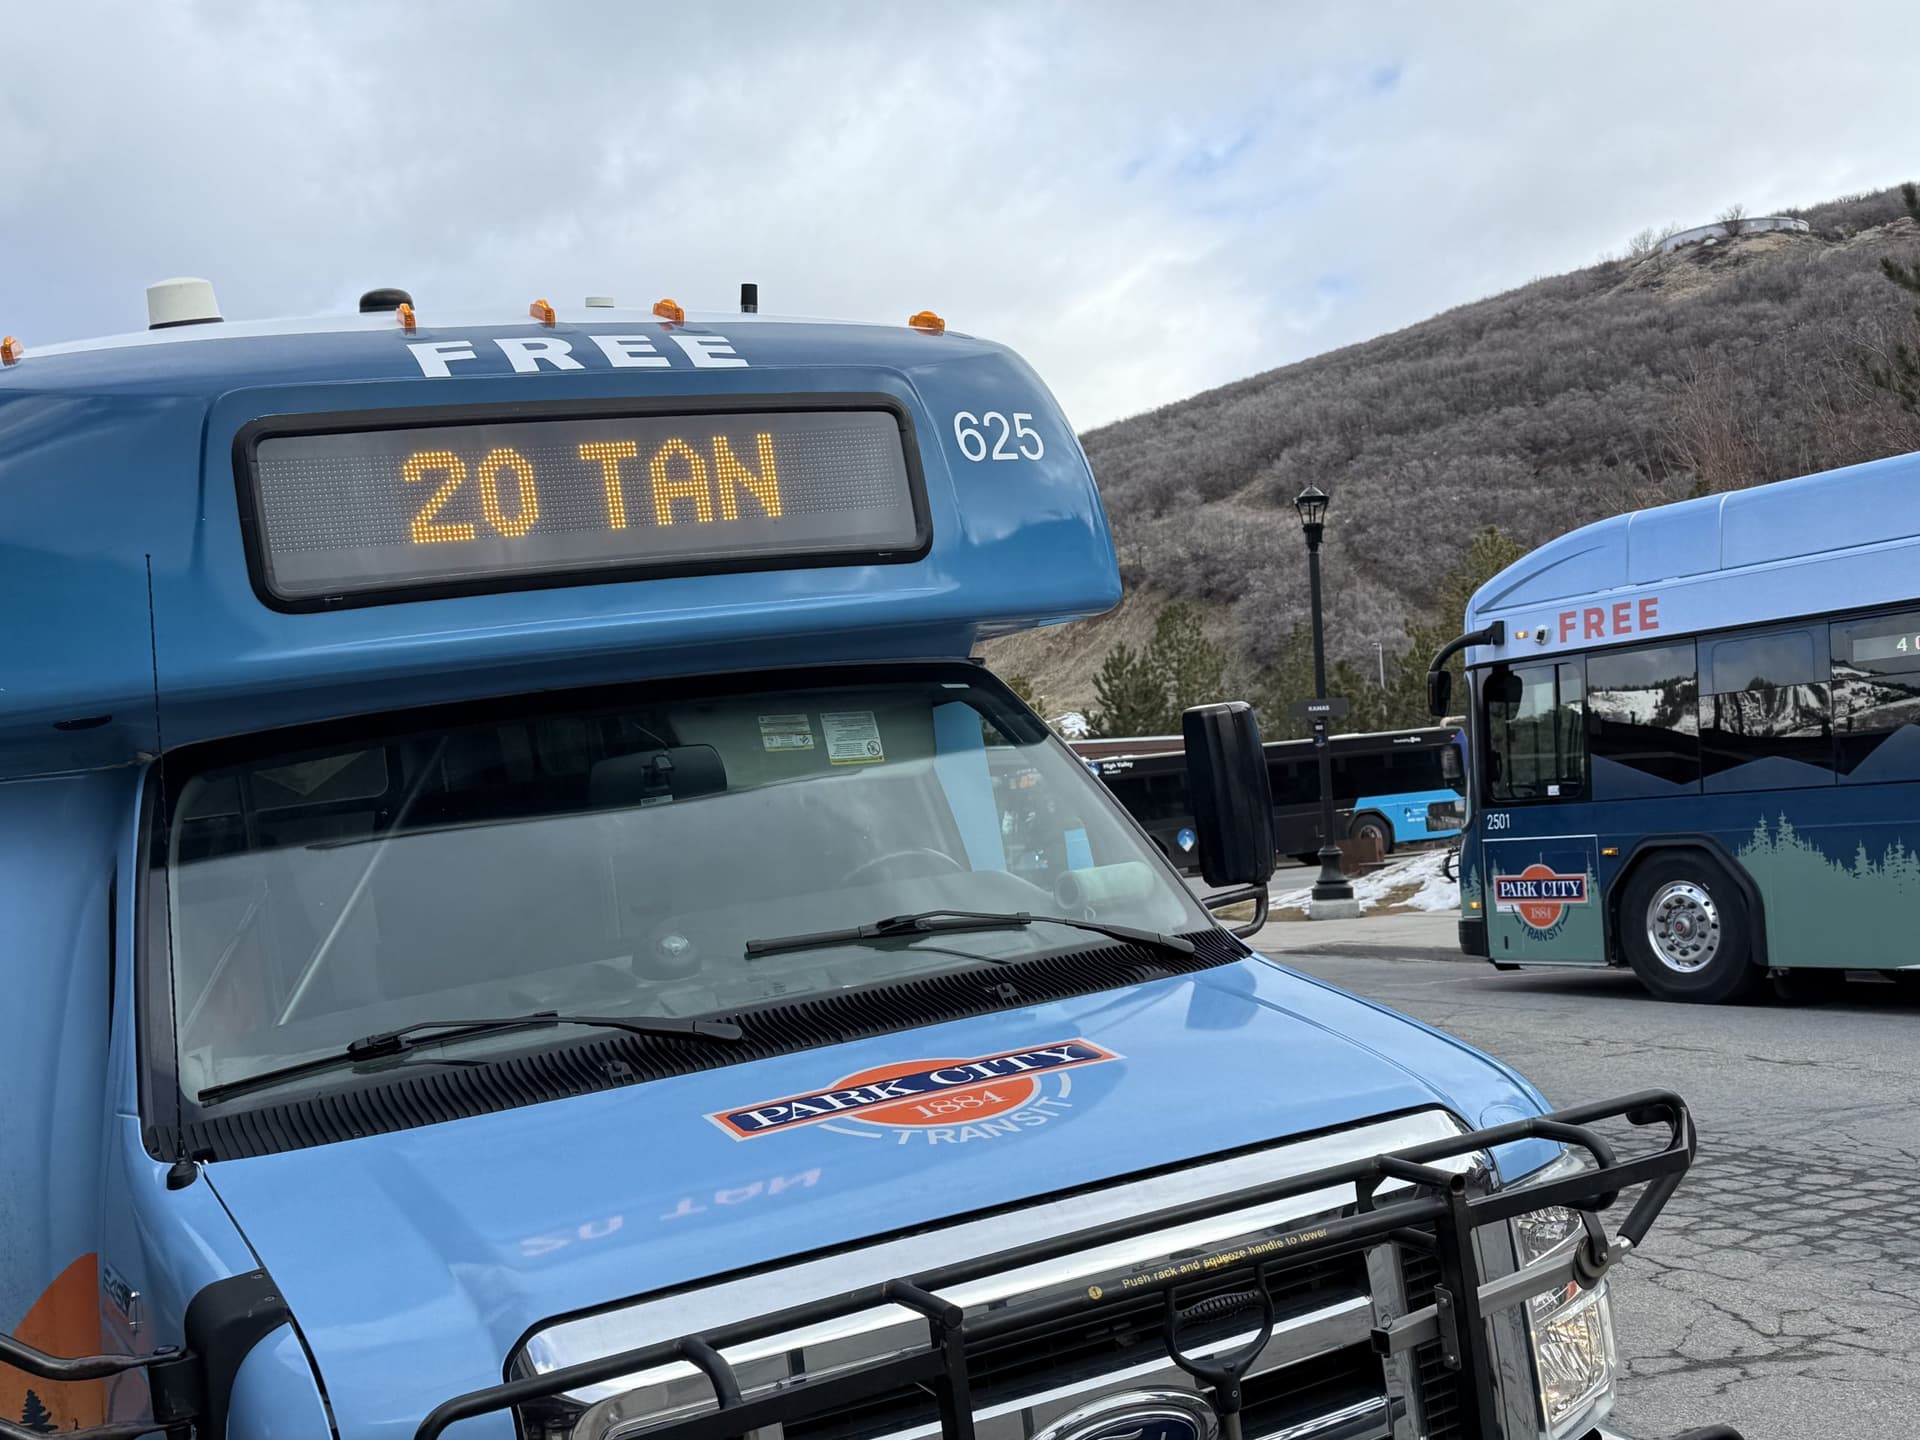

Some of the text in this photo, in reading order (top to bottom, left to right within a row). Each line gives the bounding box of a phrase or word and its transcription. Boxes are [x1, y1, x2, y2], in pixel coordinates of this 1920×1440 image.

[406, 335, 749, 379] FREE
[954, 411, 1044, 462] 625
[402, 432, 784, 544] 20 TAN
[1558, 597, 1660, 644] FREE
[1487, 813, 1511, 830] 2501
[1499, 880, 1581, 898] PARK CITY
[1522, 922, 1563, 941] TRANSIT
[1531, 907, 1552, 920] 1884
[741, 1043, 1087, 1129] PARK CITY
[911, 1089, 1009, 1120] 1884
[892, 1095, 1074, 1145] TRANSIT
[1122, 1274, 1152, 1289] Push
[1154, 1267, 1178, 1281] rack
[1180, 1260, 1201, 1274] and
[1203, 1250, 1247, 1268] squeeze
[1248, 1239, 1284, 1256] handle
[1286, 1236, 1297, 1246] to
[1299, 1228, 1328, 1243] lower
